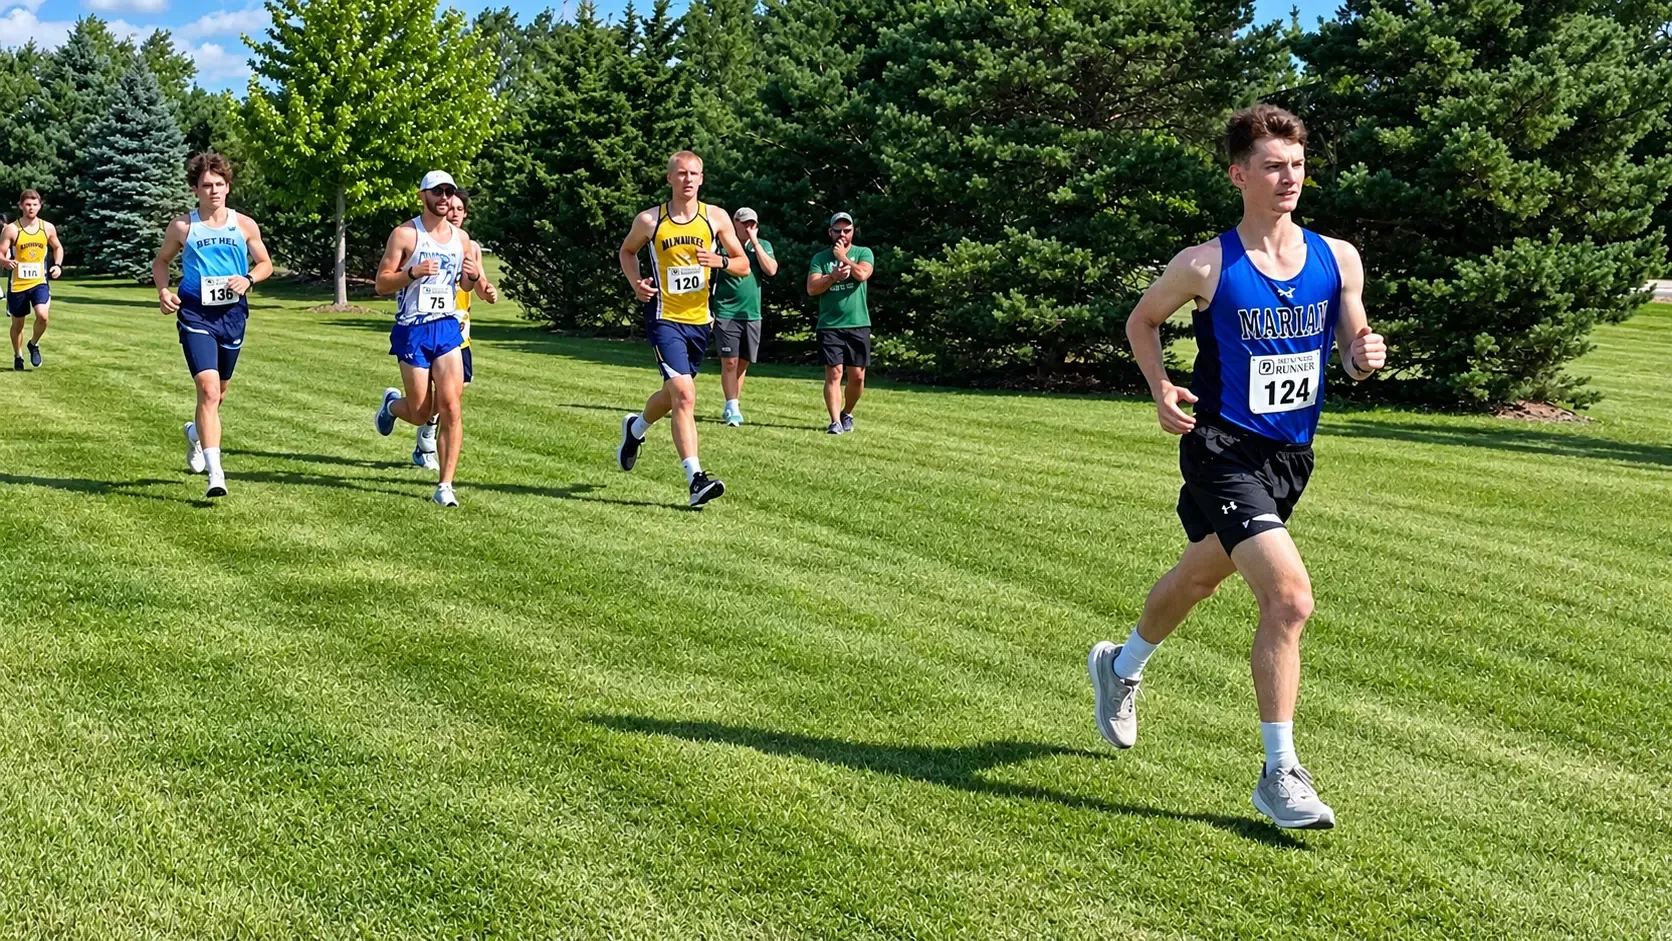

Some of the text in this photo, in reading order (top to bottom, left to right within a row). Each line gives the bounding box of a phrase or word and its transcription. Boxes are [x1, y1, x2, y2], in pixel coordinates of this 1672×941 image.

[675, 275, 700, 291] 120
[210, 288, 234, 301] 136
[430, 297, 445, 309] 75
[1276, 362, 1315, 375] RUNNER
[1264, 377, 1310, 406] 124
